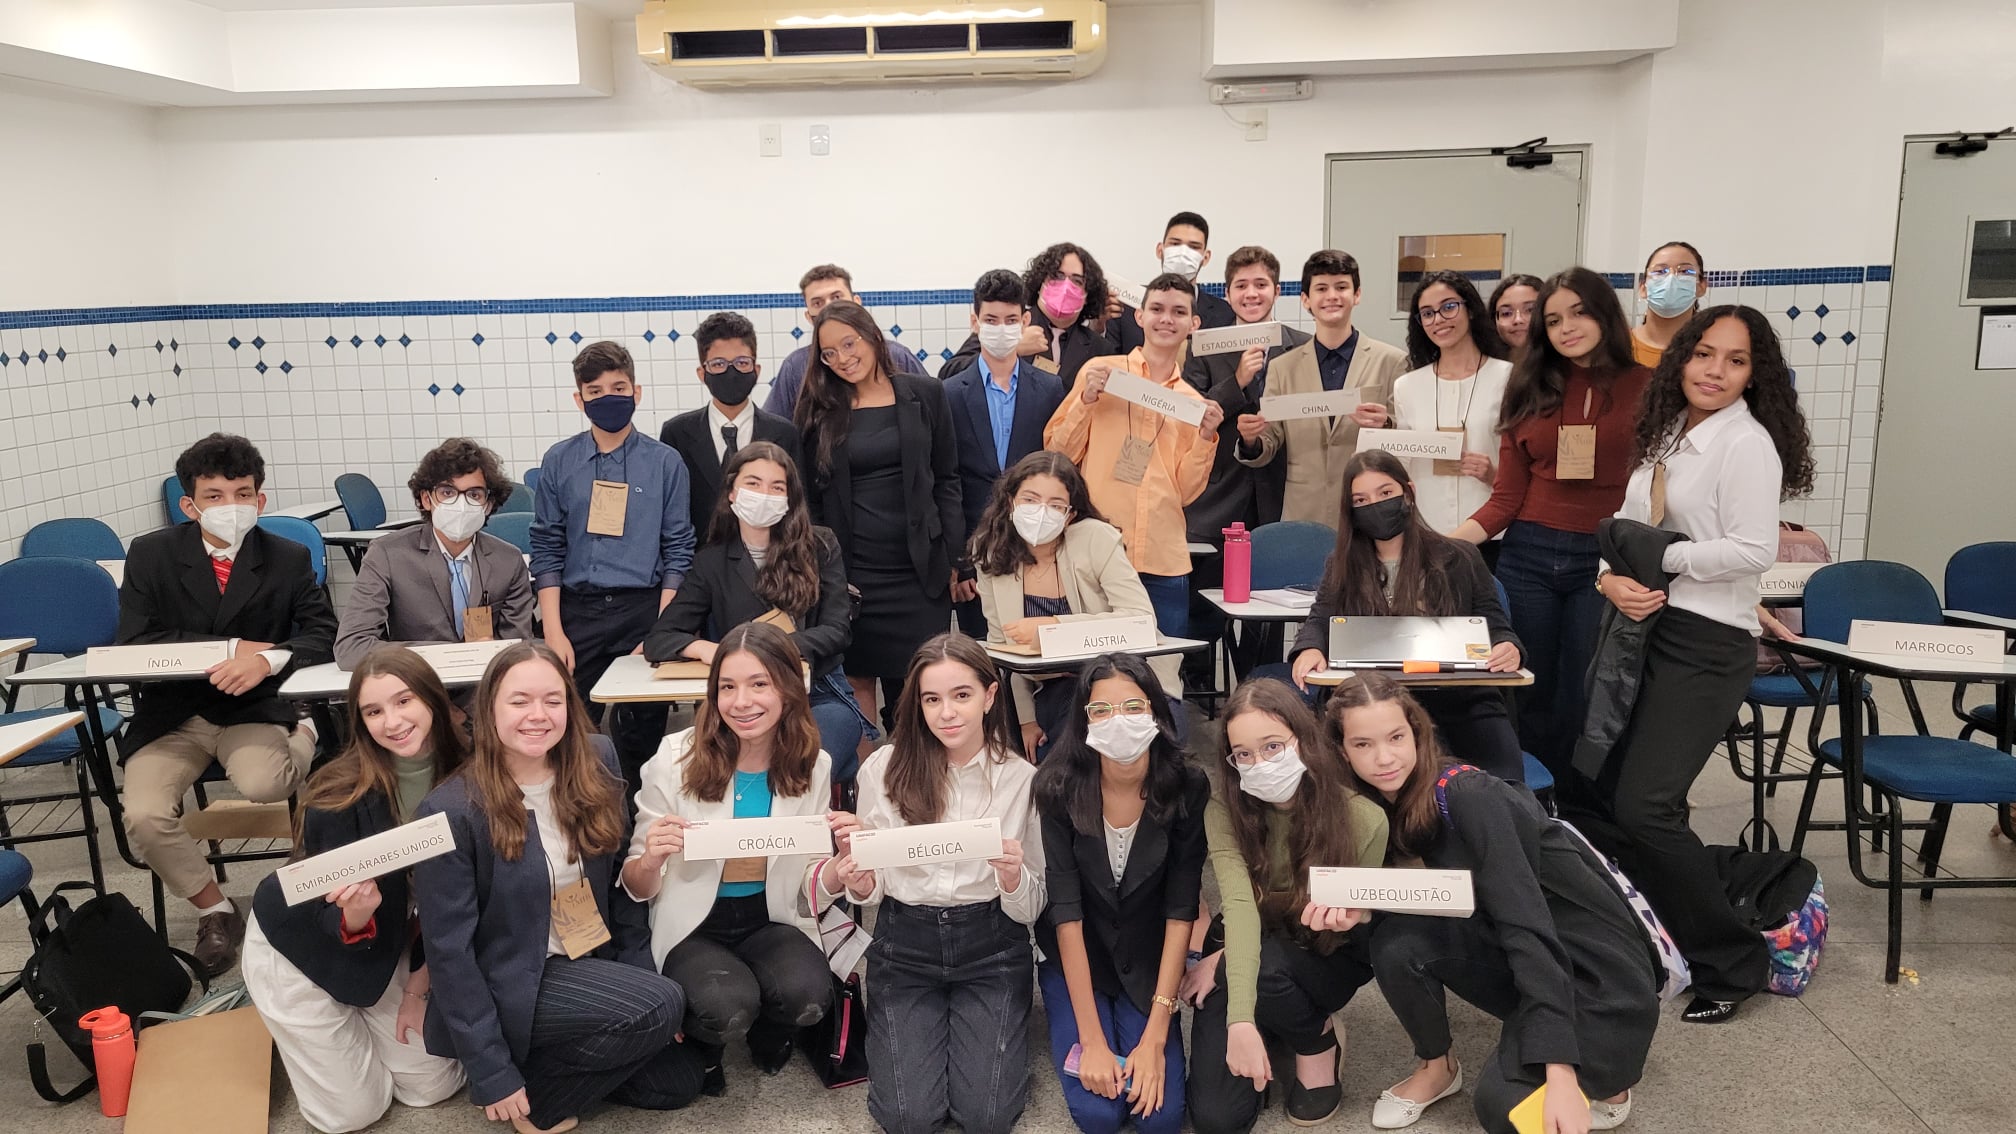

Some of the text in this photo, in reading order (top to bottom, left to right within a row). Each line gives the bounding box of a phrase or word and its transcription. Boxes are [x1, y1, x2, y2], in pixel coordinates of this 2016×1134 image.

[1201, 335, 1271, 352] ESTADOS UNIDOS
[1141, 393, 1176, 414] NIGÉRIA
[1301, 405, 1330, 415] CHINA
[1380, 442, 1447, 455] MADAGASCAR
[1760, 579, 1806, 590] LETÔNIA
[1083, 634, 1128, 649] ÁUSTRIA
[1895, 640, 1974, 656] MARROCOS
[147, 657, 183, 669] ÍNDIA
[738, 835, 796, 850] CROÁCIA
[908, 841, 964, 859] BÉLGICA
[295, 834, 445, 894] EMIRADOS ÁRABES UNIDOS
[1349, 887, 1452, 903] UZBEQUISTÃO
